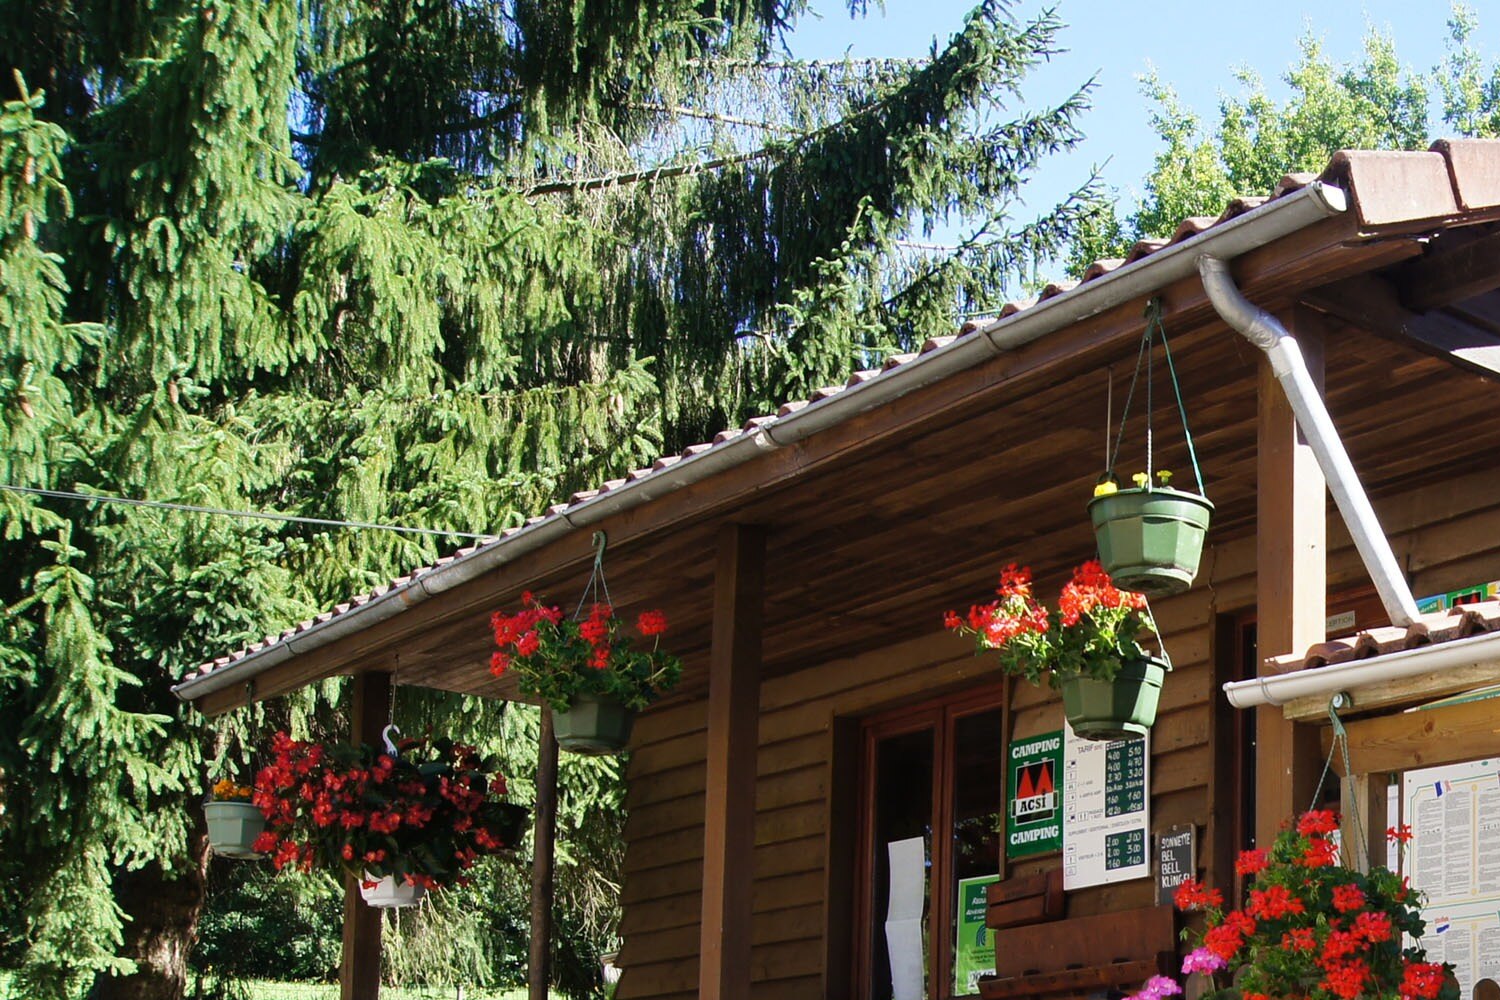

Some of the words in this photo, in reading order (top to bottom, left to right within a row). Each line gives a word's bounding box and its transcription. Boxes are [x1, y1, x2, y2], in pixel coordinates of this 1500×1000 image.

[1012, 737, 1061, 759] CAMPING
[1020, 795, 1047, 813] ACSI
[1010, 825, 1060, 846] CAMPING
[1161, 832, 1191, 849] SONNETTE
[1161, 850, 1176, 861] BEL
[1161, 861, 1181, 875] BELL
